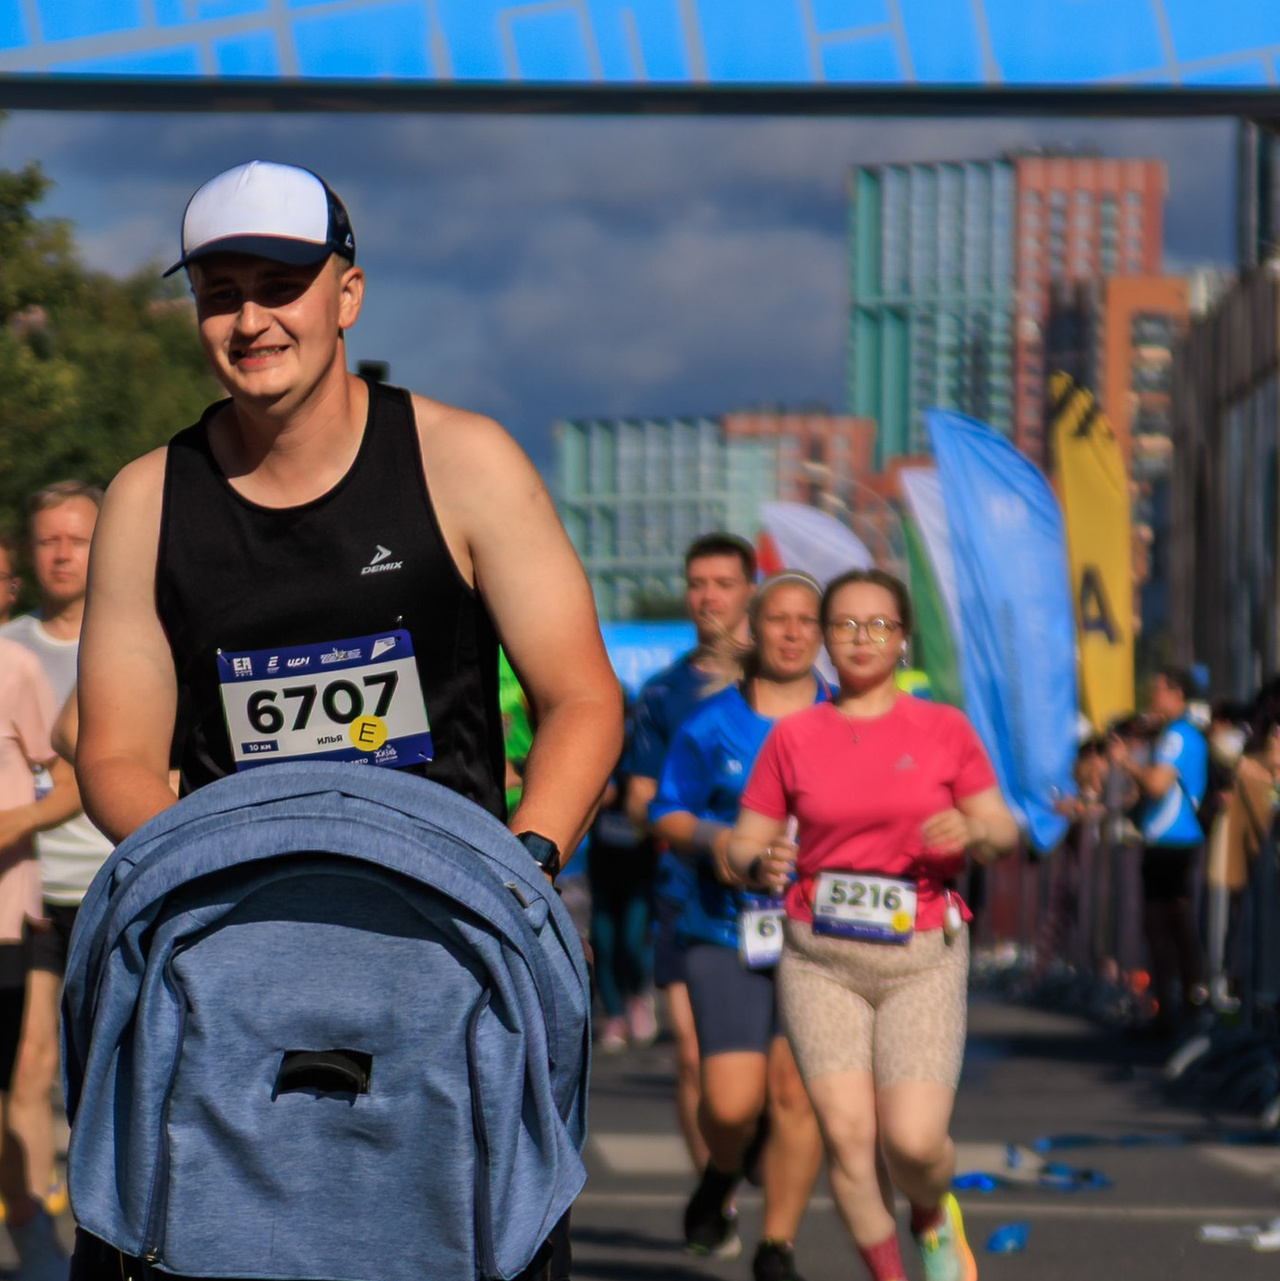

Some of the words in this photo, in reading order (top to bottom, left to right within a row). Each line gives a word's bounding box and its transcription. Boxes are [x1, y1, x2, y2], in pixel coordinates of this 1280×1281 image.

[361, 561, 403, 575] DEMIX
[247, 670, 399, 734] 6707
[317, 734, 343, 745] ИЛЬЯ
[359, 722, 377, 743] Е
[829, 879, 902, 910] 5216
